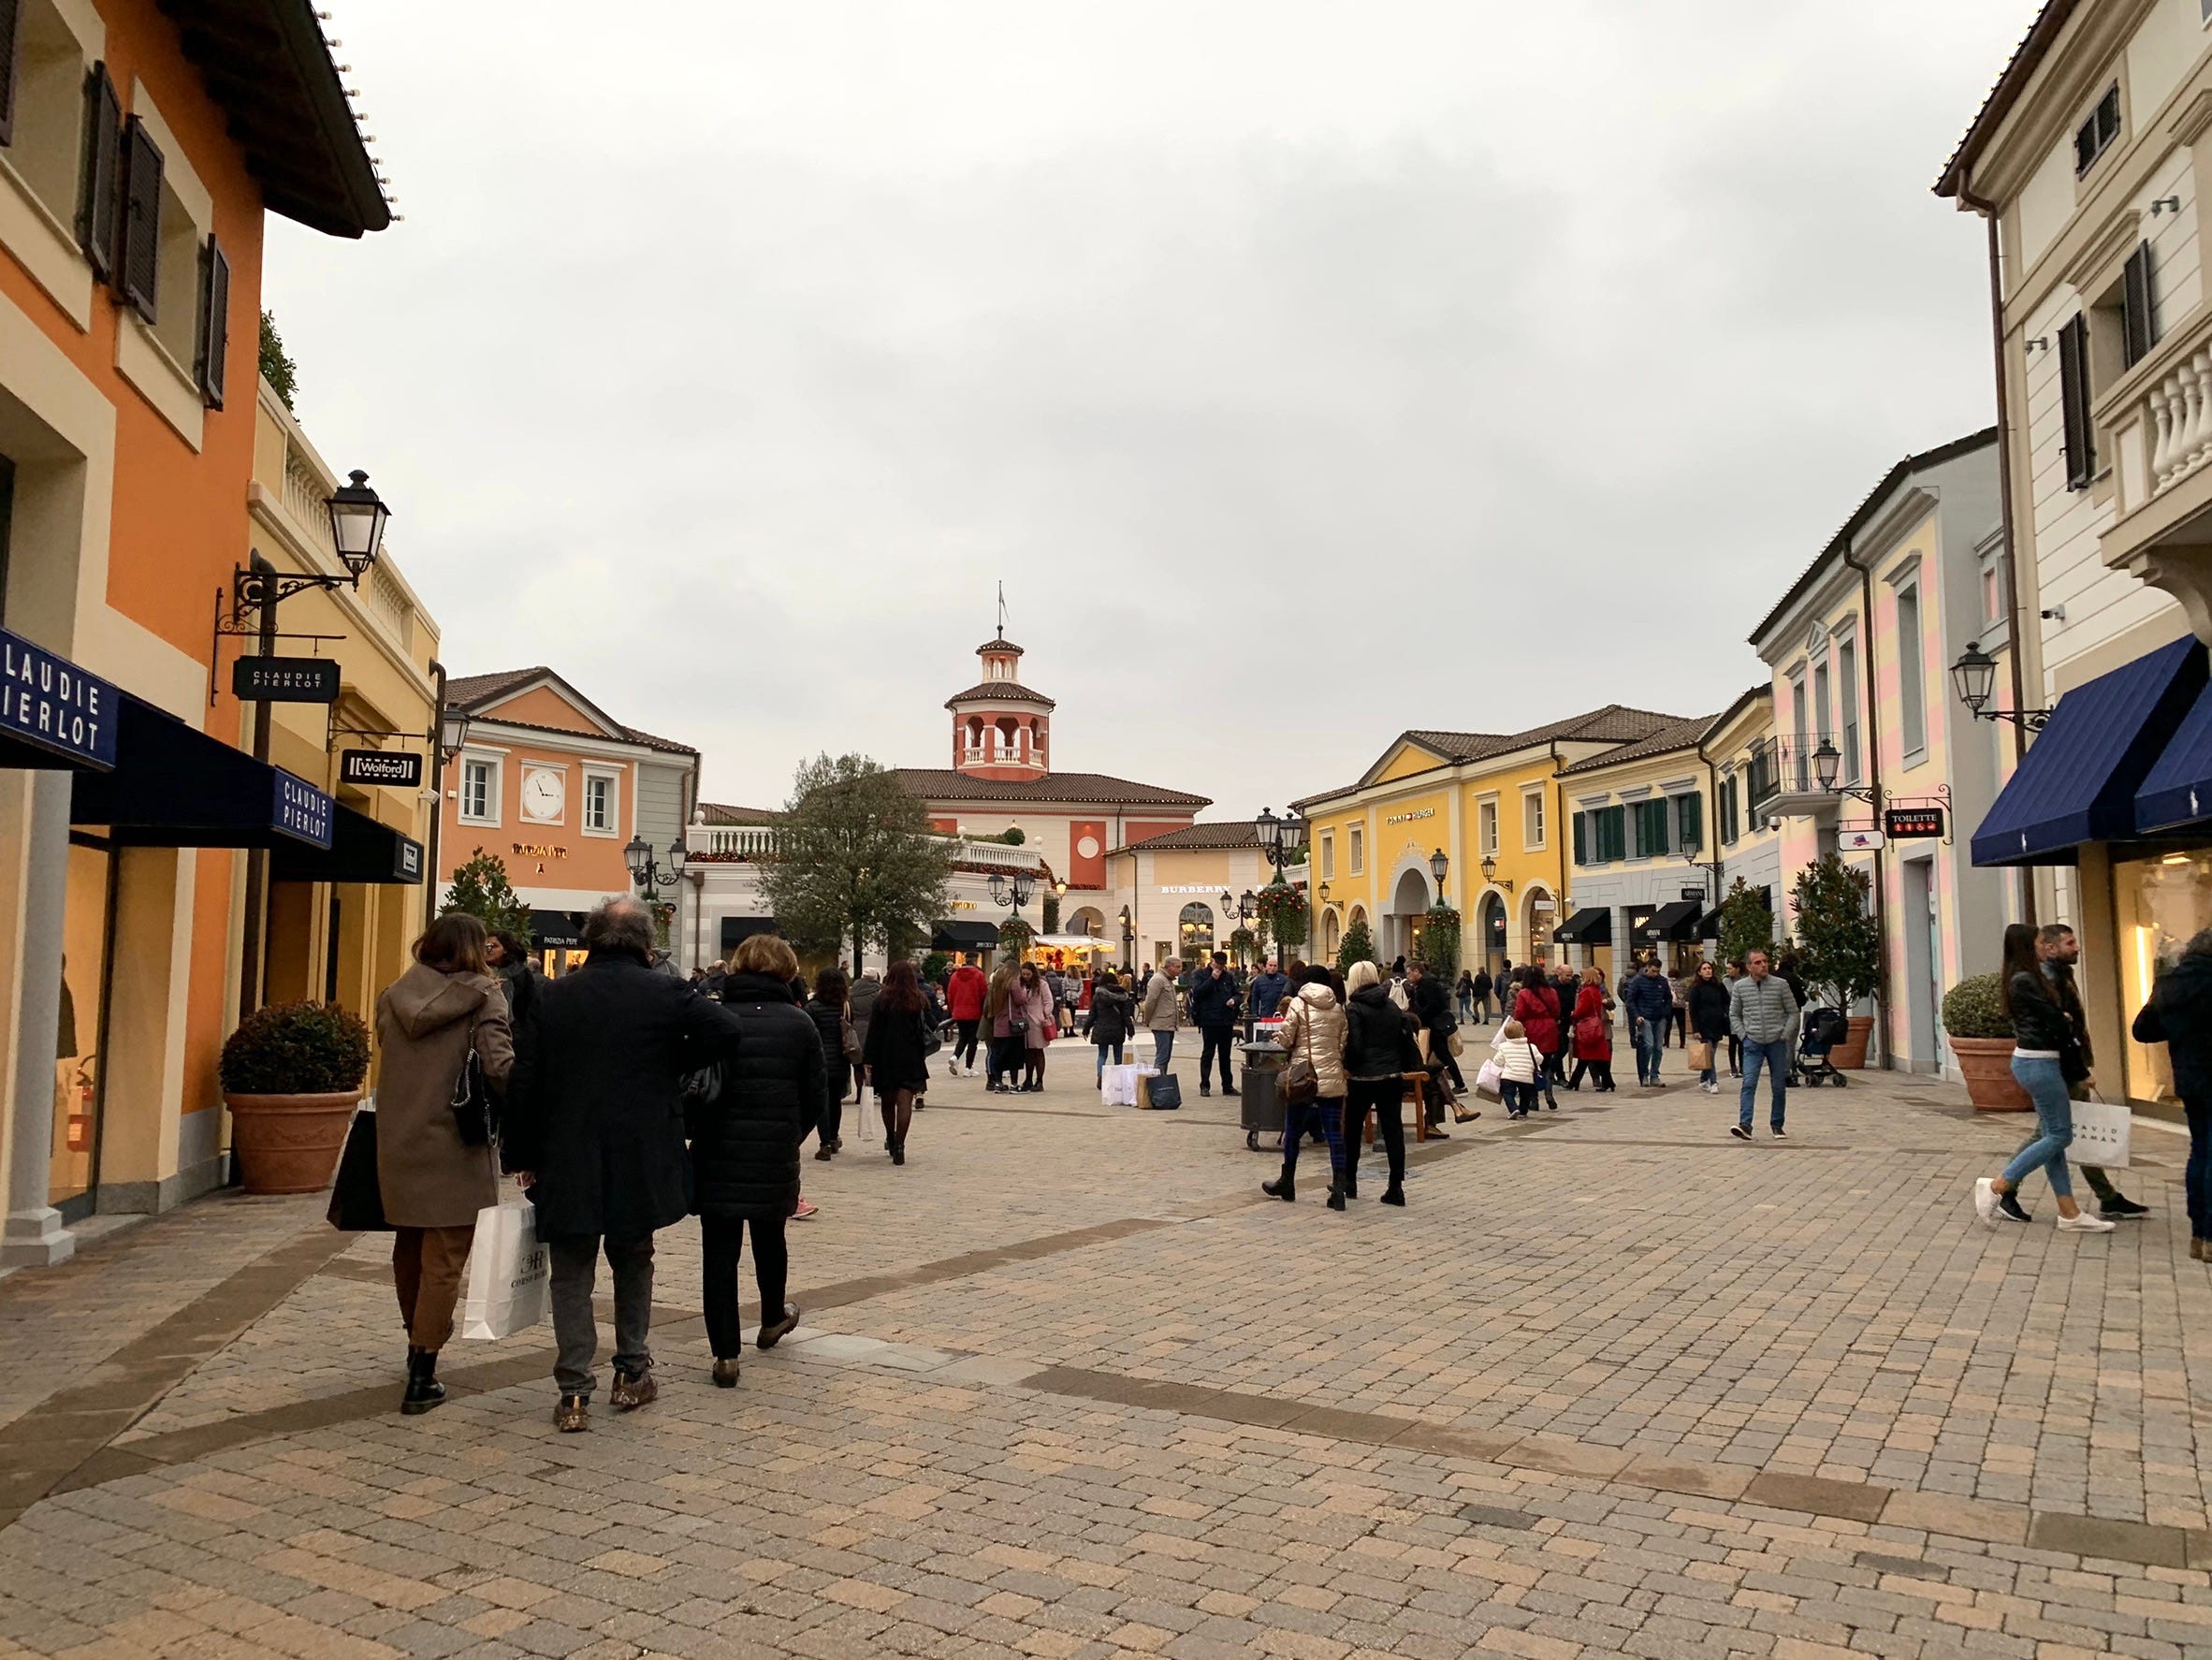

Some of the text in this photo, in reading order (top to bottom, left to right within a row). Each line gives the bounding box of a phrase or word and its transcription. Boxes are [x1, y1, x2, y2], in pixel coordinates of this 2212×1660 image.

[6, 644, 98, 716] LAUDIE
[254, 671, 321, 680] CLAUDIE
[254, 678, 321, 688] PIERLOT
[4, 685, 98, 750] IERLOT
[360, 762, 402, 774] Wolford
[284, 780, 327, 817] CLAUDIE
[284, 805, 326, 838] PIERLOT
[1891, 814, 1937, 823] TOILETTE
[1161, 885, 1230, 894] BURBERRY
